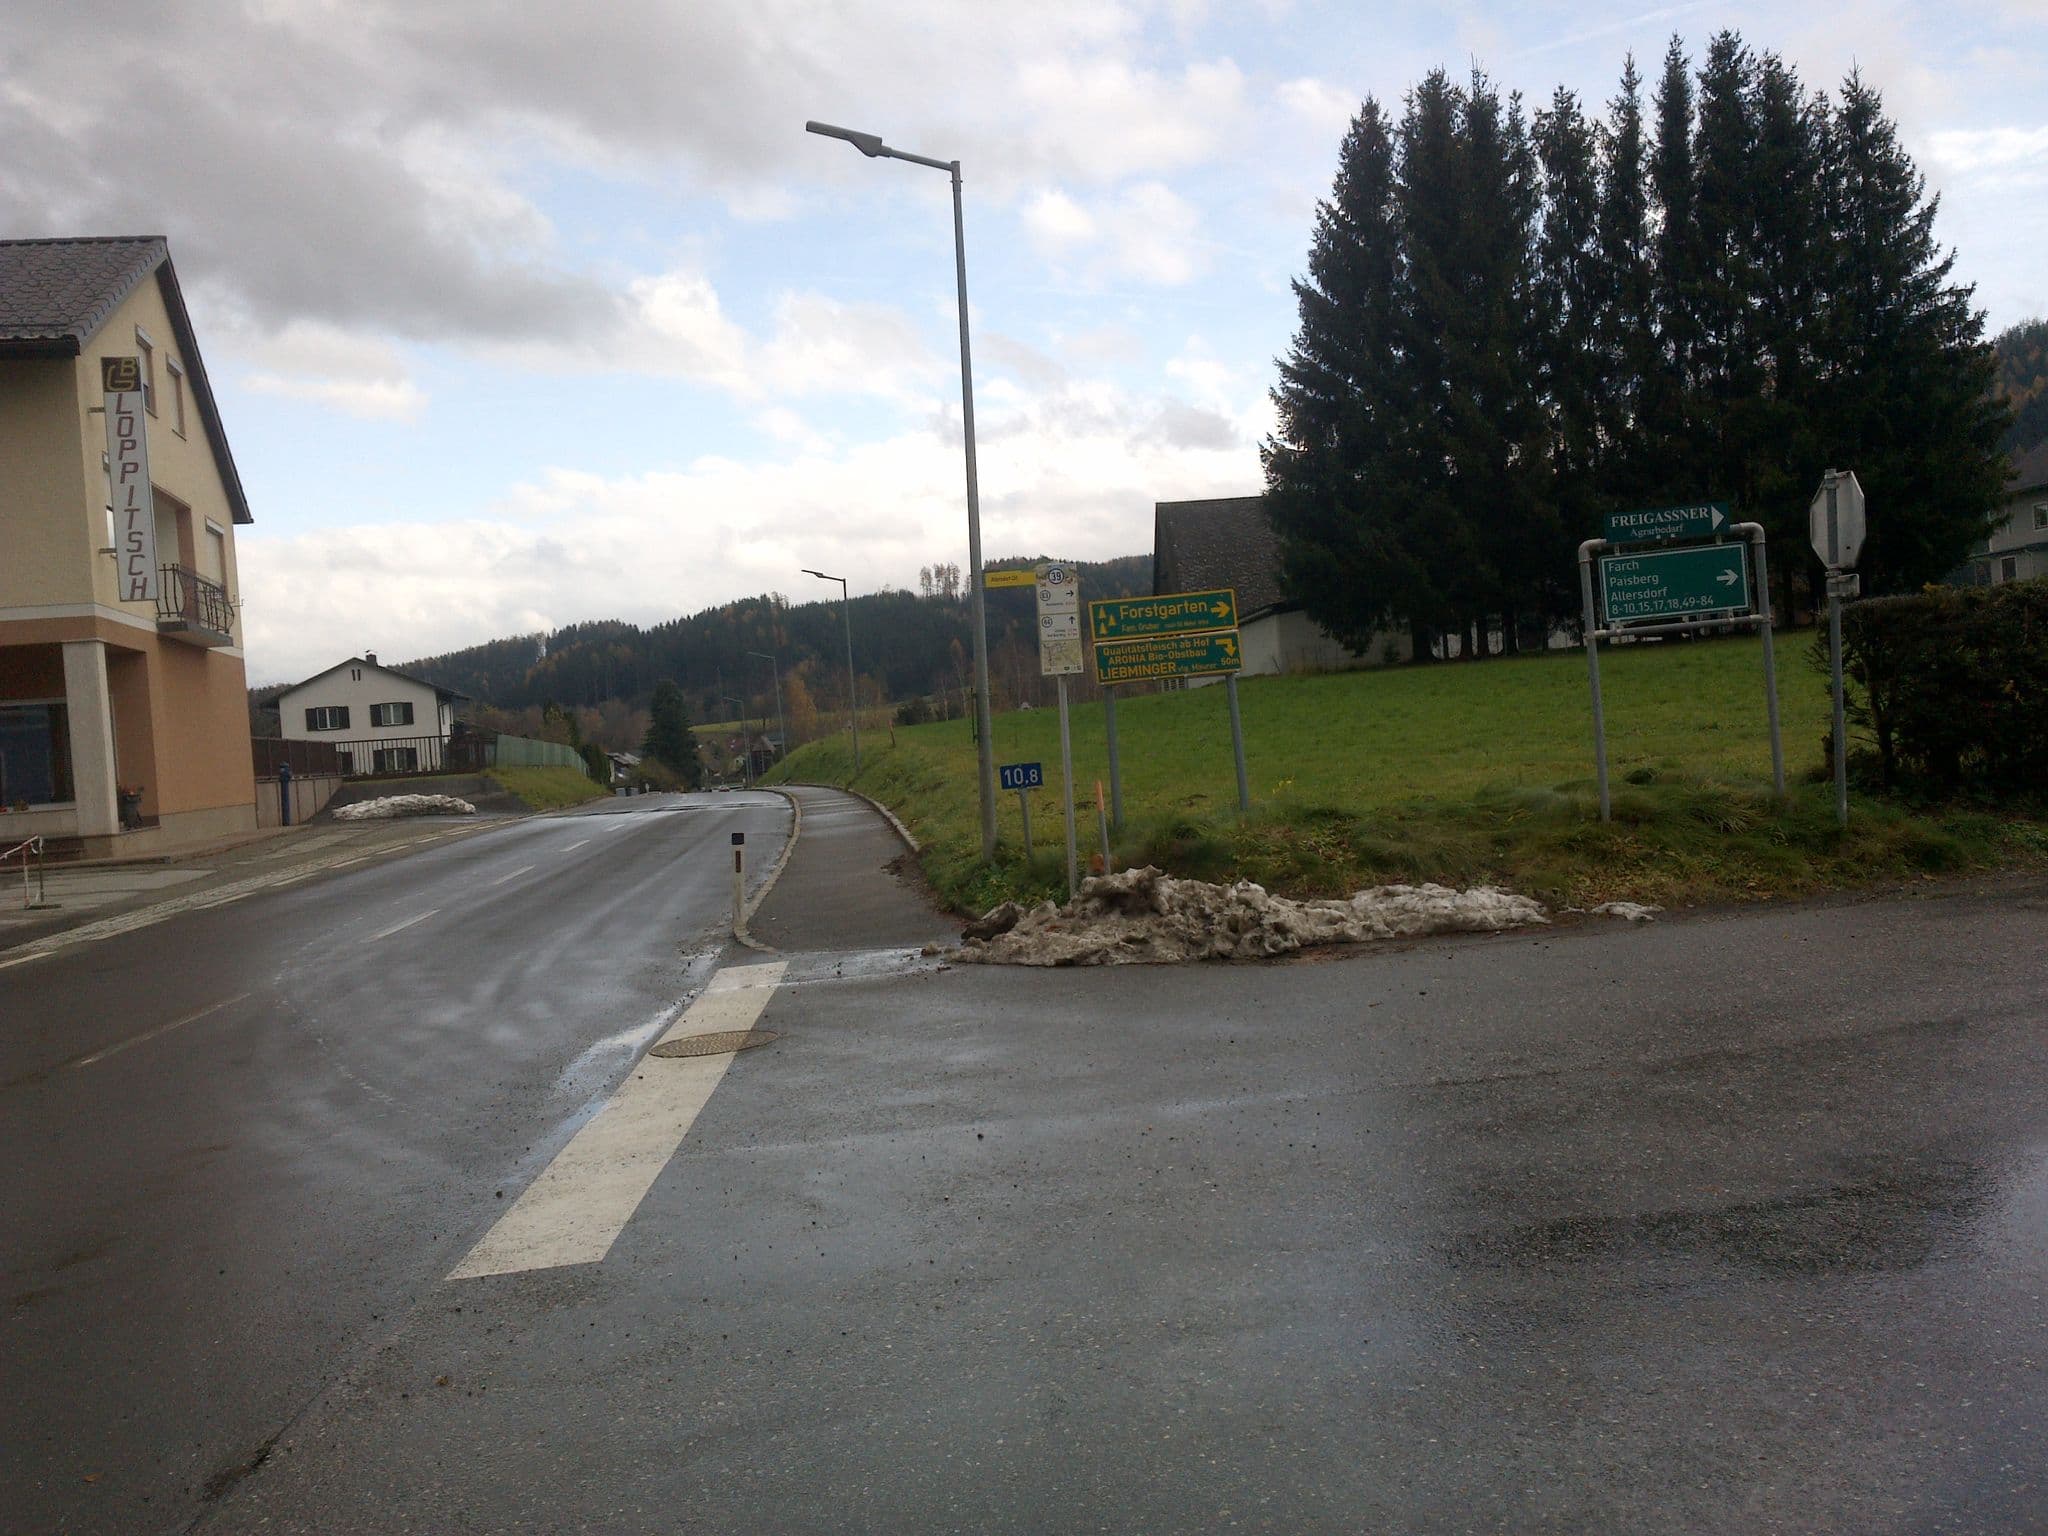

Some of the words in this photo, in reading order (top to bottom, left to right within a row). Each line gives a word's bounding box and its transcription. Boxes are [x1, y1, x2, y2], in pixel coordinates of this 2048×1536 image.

[114, 392, 148, 600] LOPPITSCH
[1610, 506, 1710, 528] FREIGASSNER
[1630, 523, 1684, 539] Agrarbedarf
[1608, 560, 1639, 573] Farch
[1609, 573, 1659, 588] Paisberg
[1610, 586, 1668, 602] Allersdorf
[1119, 600, 1208, 620] Forstgarten
[1102, 641, 1178, 656] Qualitätsfleisch
[1180, 639, 1192, 648] ab
[1194, 637, 1210, 647] Hof
[1108, 653, 1146, 666] ARONIA
[1148, 648, 1207, 662] Bio-Obstbau
[1220, 657, 1240, 667] 50m
[1099, 662, 1177, 680] LIEBMINGER
